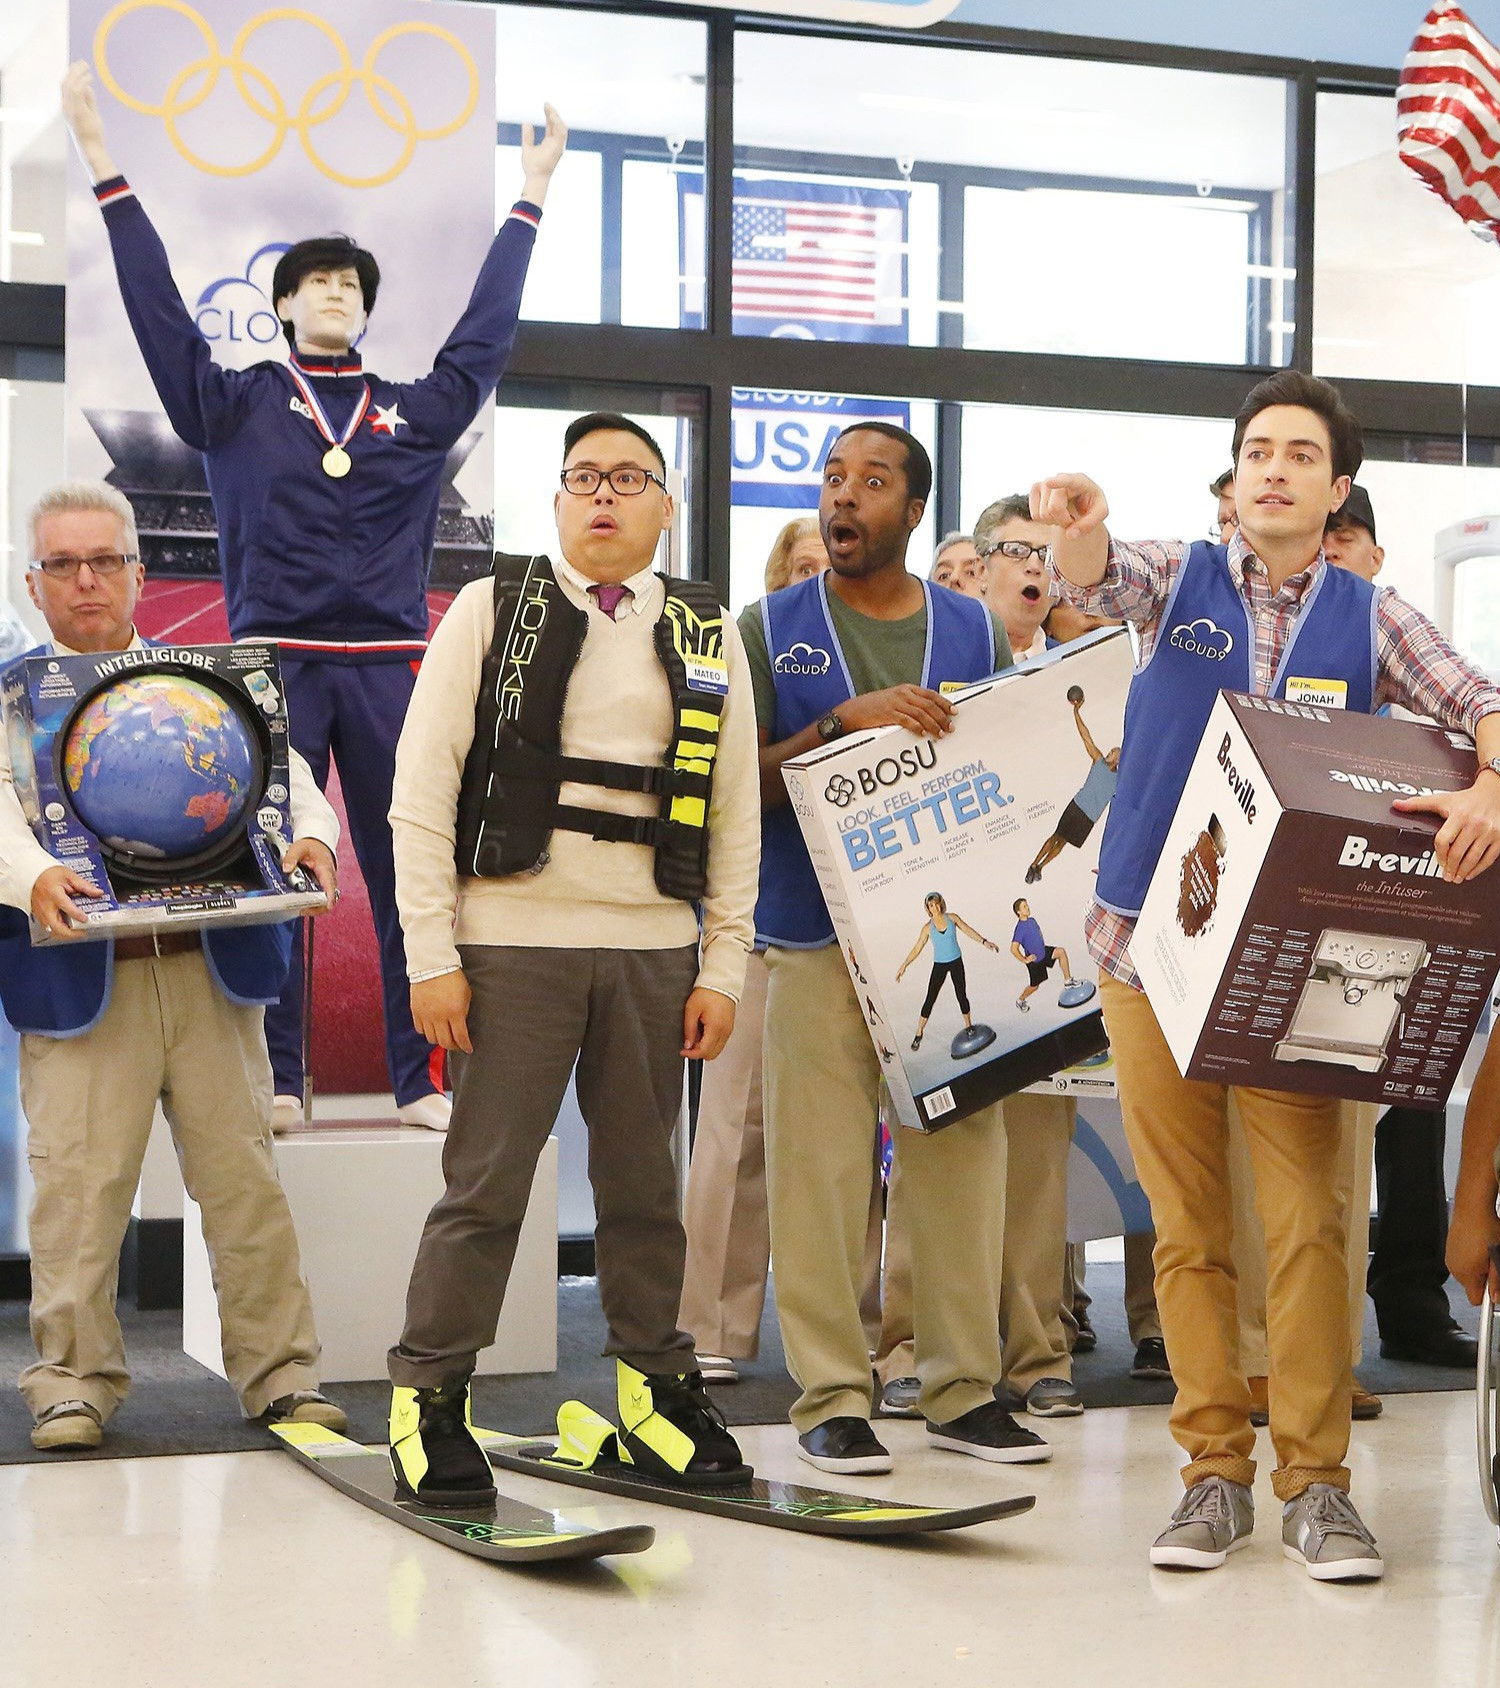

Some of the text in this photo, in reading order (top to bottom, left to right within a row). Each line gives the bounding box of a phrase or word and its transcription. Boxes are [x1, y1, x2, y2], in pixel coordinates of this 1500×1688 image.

[196, 307, 279, 343] CLO
[1169, 634, 1227, 662] CLOUD9
[93, 648, 217, 678] INTELLIGLOBE
[694, 668, 721, 681] MATEO
[775, 663, 829, 676] CLOUD9
[1296, 693, 1335, 705] JONAH
[857, 740, 937, 795] BOSU
[1216, 731, 1257, 825] Breville
[1328, 769, 1451, 798] reville
[260, 813, 279, 822] TRY
[262, 820, 279, 829] ME
[841, 771, 1015, 873] BETTER.
[987, 818, 1016, 835] MOVEMENT
[1337, 835, 1445, 878] Brevil
[1356, 880, 1428, 899] the Infuser
